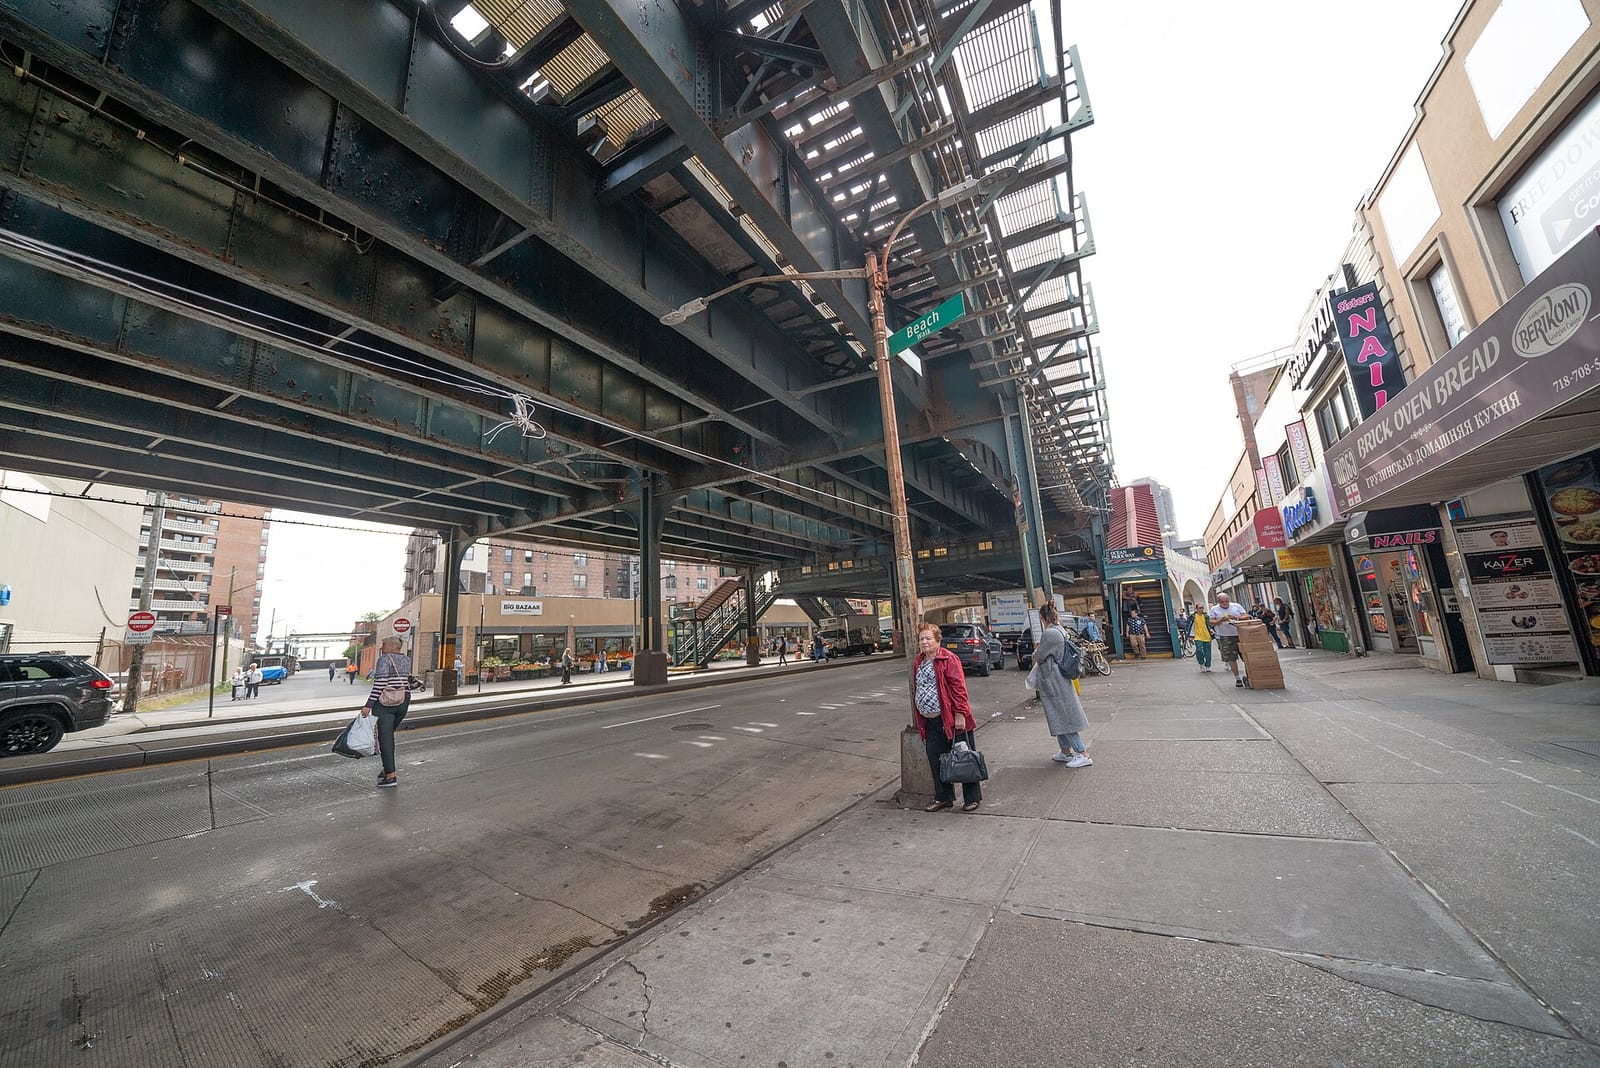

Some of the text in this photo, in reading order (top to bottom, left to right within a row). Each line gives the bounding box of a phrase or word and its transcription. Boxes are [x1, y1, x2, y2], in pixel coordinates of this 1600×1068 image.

[1509, 122, 1600, 226] FREE DOW
[1574, 192, 1600, 218] Go
[1337, 292, 1375, 313] Sisters
[906, 311, 940, 338] Beach
[1518, 291, 1581, 350] BERIKONI
[917, 328, 931, 340] Walk
[1357, 335, 1501, 460] BRICK OVEN BREAD
[1365, 390, 1522, 489] ГРУЗИНСКАЯ ДОМАШНЯЯ КУХНЯ
[1374, 531, 1435, 548] NAILS
[1483, 551, 1534, 572] KAIZER
